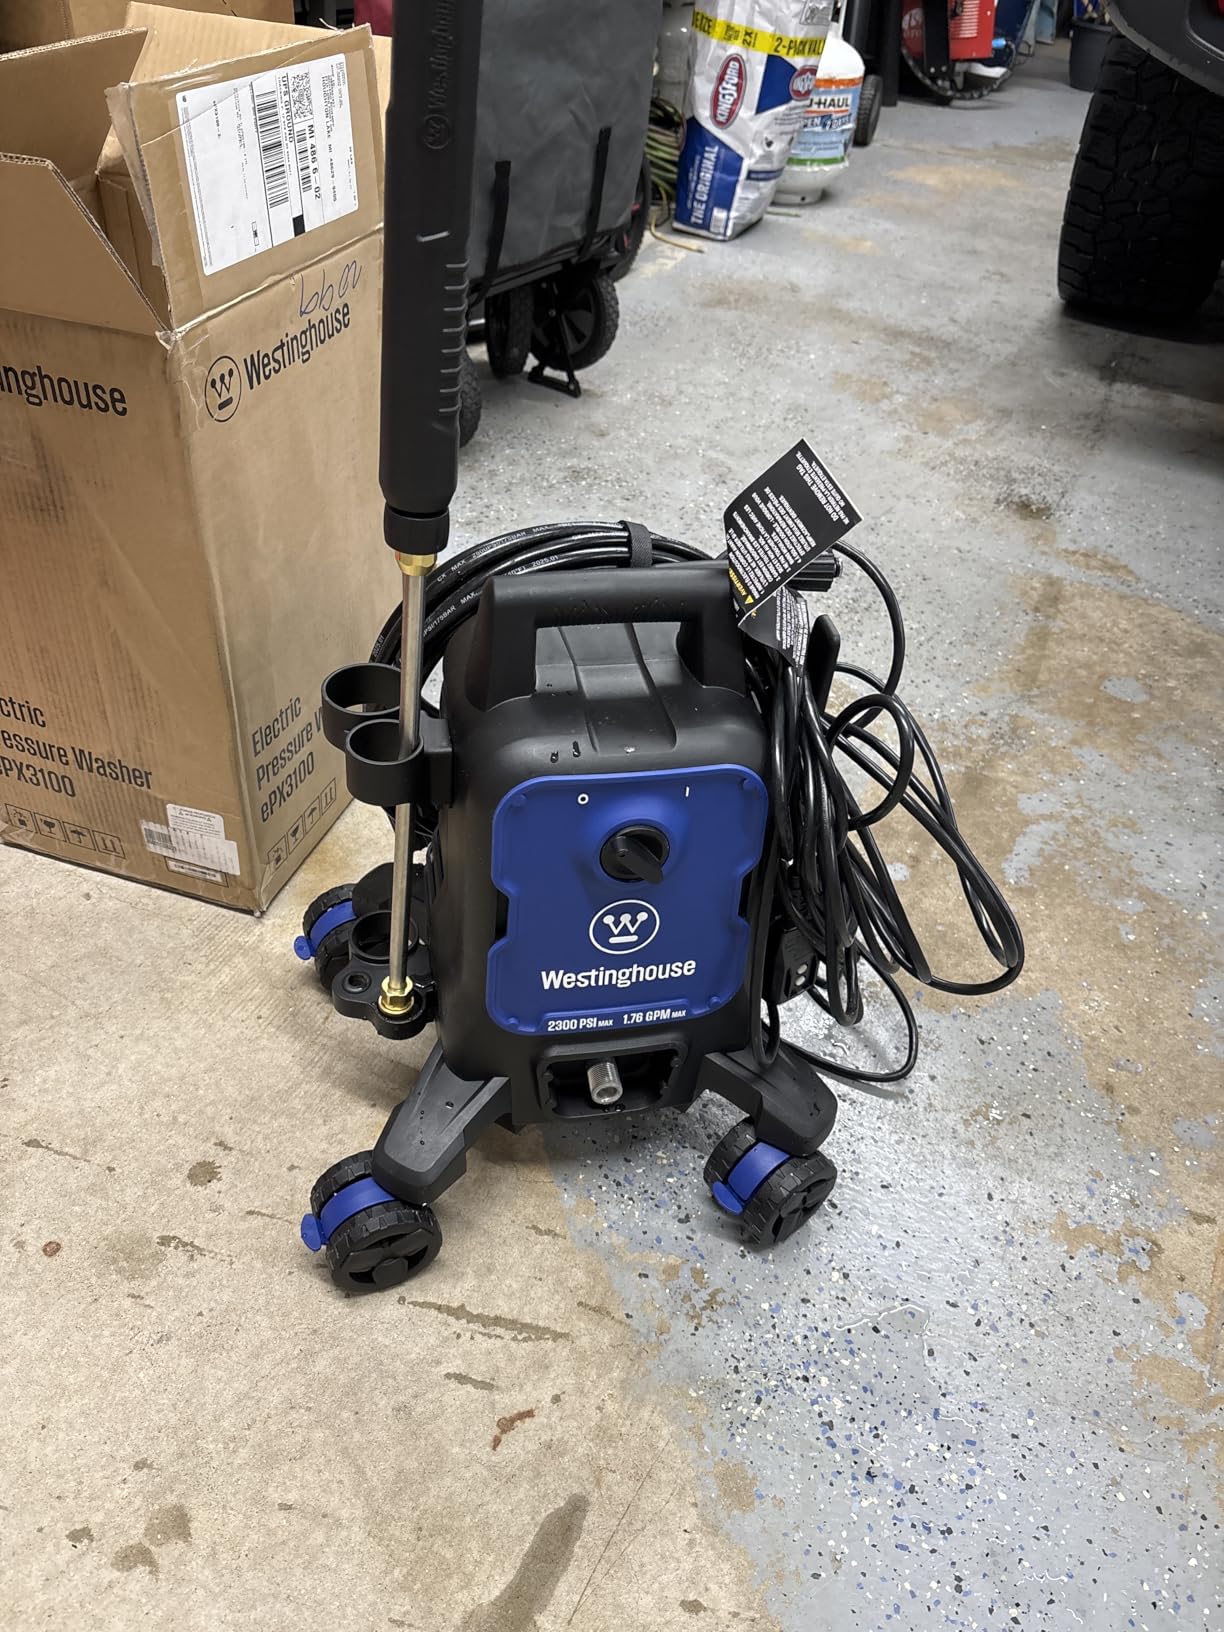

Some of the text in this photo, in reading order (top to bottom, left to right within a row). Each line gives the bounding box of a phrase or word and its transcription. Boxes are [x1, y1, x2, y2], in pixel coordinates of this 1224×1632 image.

[321, 76, 329, 119] HOUGHTON
[716, 60, 740, 123] KINGSFORD
[284, 100, 293, 143] GROUND
[307, 123, 314, 139] MI
[309, 142, 317, 163] 486
[696, 145, 720, 202] ORIGINAL
[691, 197, 704, 225] THE
[243, 302, 351, 391] Westinghouse
[763, 486, 771, 494] DE
[795, 463, 839, 521] DO NOT REMOVE THIS TAG
[823, 478, 834, 491] ESTA
[823, 489, 830, 497] LA
[751, 492, 761, 505] VOUS
[827, 494, 841, 512] RETIRER
[743, 504, 752, 514] LES
[748, 511, 759, 523] AVEC
[758, 502, 774, 522] LORSQUE
[777, 505, 786, 515] DES
[837, 509, 846, 519] PAS
[755, 521, 766, 535] FICHE
[772, 522, 786, 539] DOUBLE
[782, 513, 801, 537] SEULEMENT
[784, 526, 792, 537] DES
[793, 517, 816, 547] REMPLACEMENT
[763, 532, 770, 540] LA
[733, 537, 748, 555] UTILISER
[752, 540, 760, 550] LES
[762, 543, 770, 551] AU
[766, 537, 781, 557] TOUCHER
[531, 554, 559, 568] 2025.01
[734, 549, 748, 567] CORDON
[744, 553, 753, 563] PAS
[757, 547, 770, 564] TOUTES
[766, 549, 775, 560] NON
[778, 554, 786, 564] PAS
[449, 558, 467, 572] MAX
[756, 559, 764, 568] EST
[766, 561, 778, 578] GARDEZ
[774, 562, 784, 574] SECS
[782, 561, 789, 569] NE
[761, 565, 773, 582] CORDON
[252, 696, 301, 758] Electric
[256, 722, 313, 791] Pressure
[0, 755, 76, 798] PX3100
[71, 746, 152, 790] Washer
[260, 751, 315, 824] ePX3100
[541, 959, 698, 991] Westinghouse
[547, 1008, 687, 1032] 2300 PSI MAX 1.76 GPM MAX
